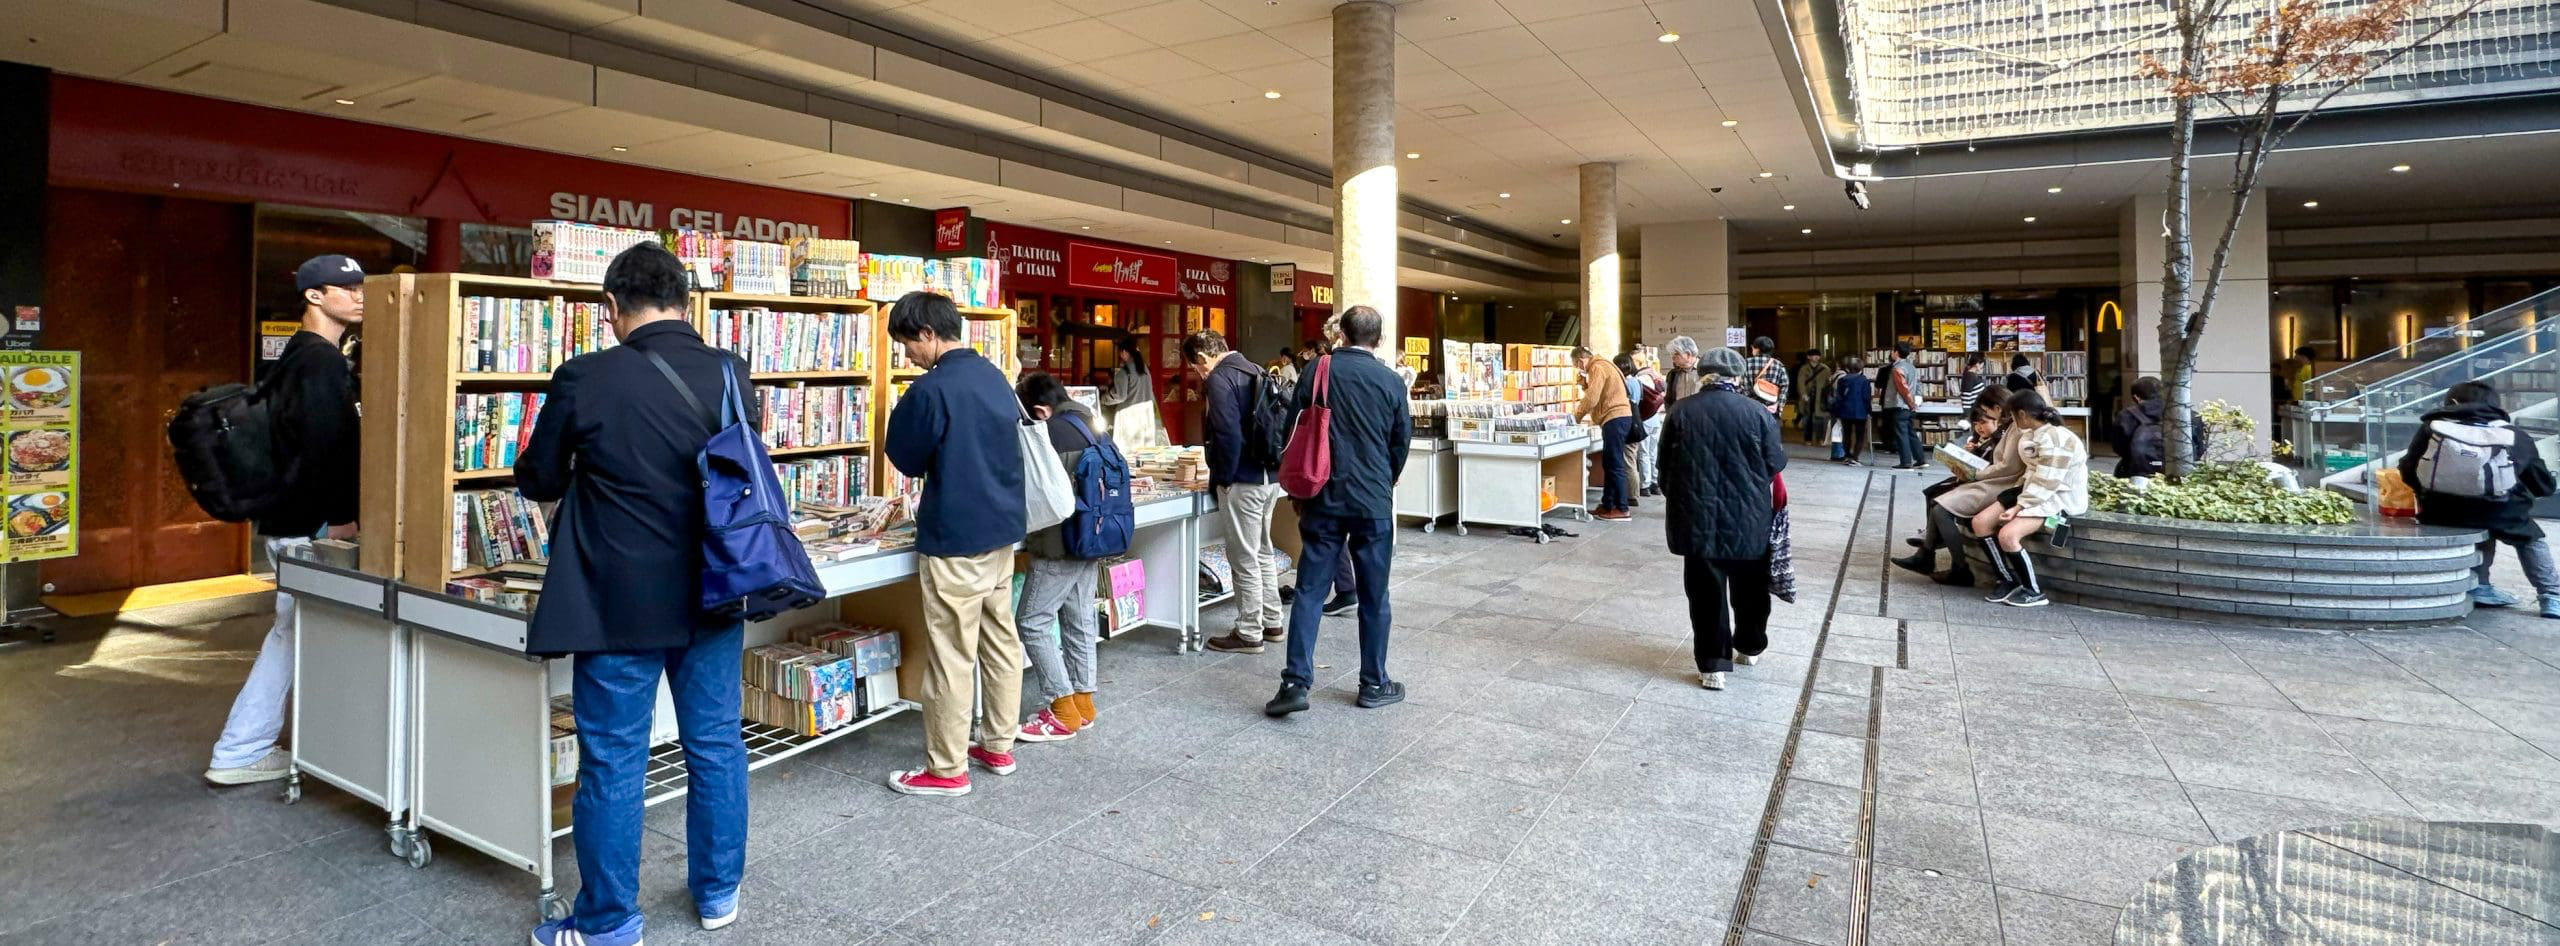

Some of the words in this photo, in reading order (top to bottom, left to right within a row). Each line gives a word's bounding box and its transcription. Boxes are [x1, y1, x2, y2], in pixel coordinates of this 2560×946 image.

[550, 192, 653, 229] SIAM
[669, 208, 819, 242] CELADON
[1012, 245, 1061, 262] TRATTORIA
[1016, 262, 1056, 277] d'ITALIA
[1186, 269, 1210, 281] PIZZA
[1310, 285, 1333, 305] YEBI
[1406, 339, 1429, 353] YEBISU
